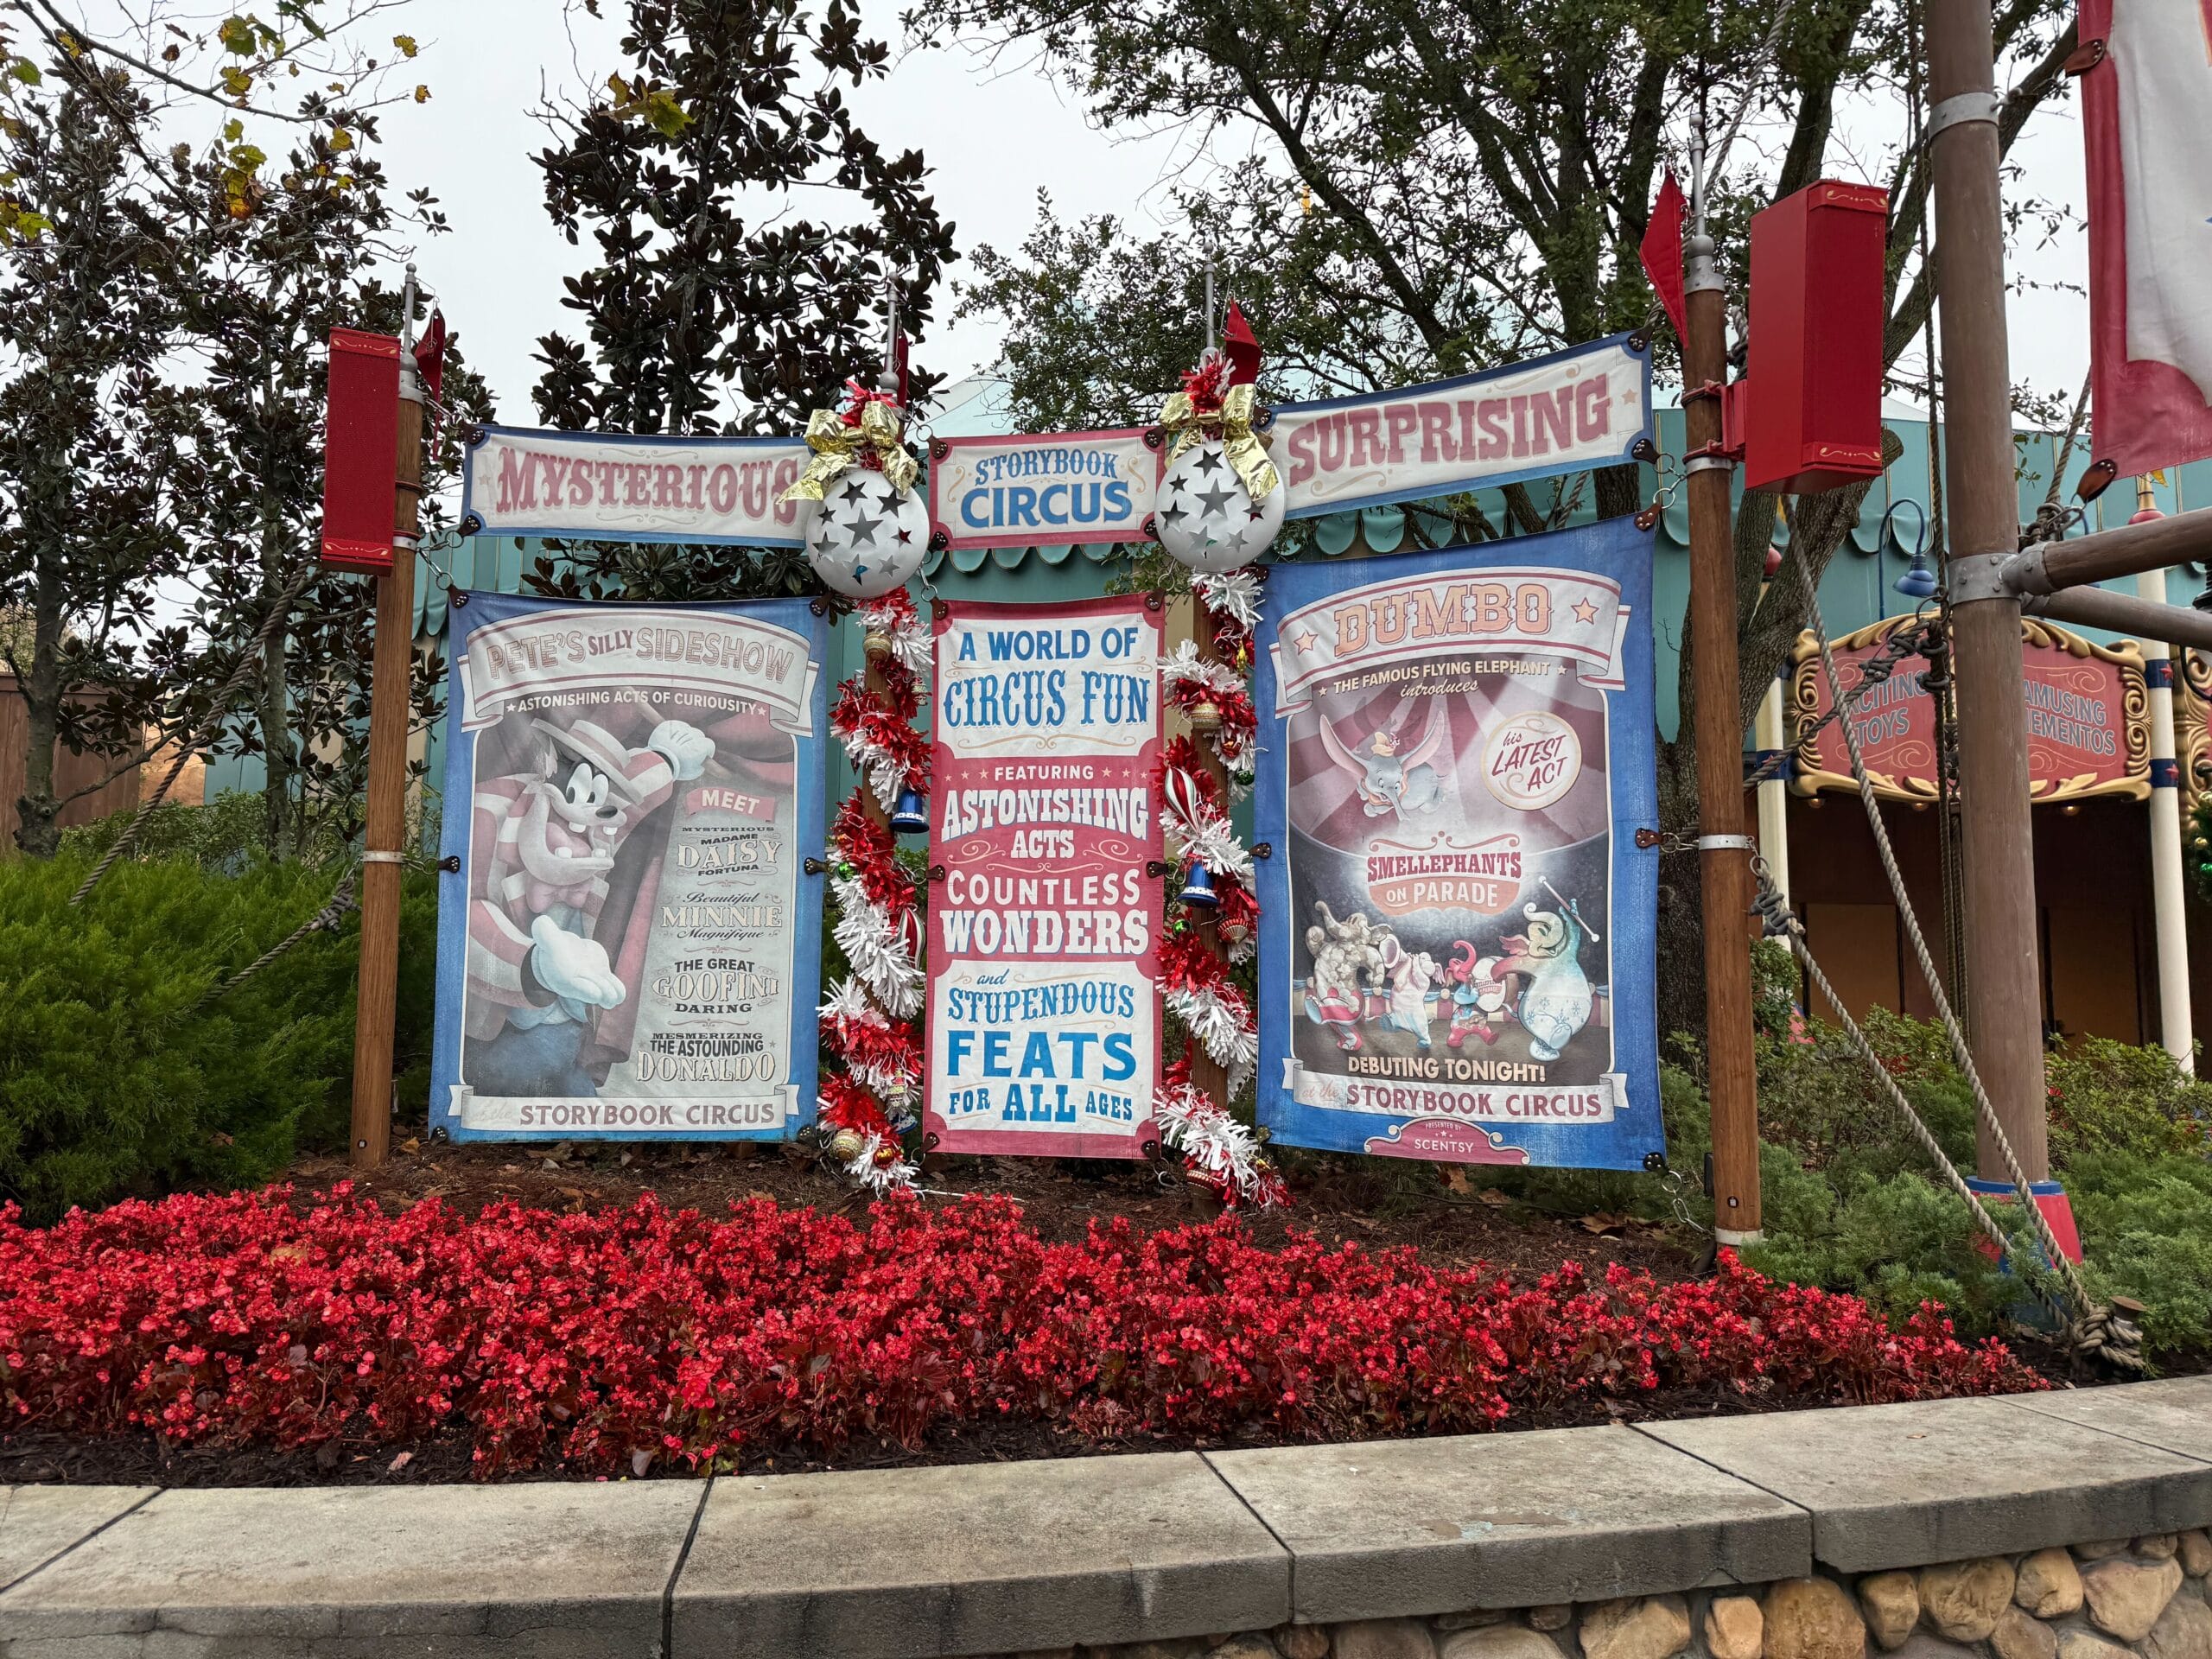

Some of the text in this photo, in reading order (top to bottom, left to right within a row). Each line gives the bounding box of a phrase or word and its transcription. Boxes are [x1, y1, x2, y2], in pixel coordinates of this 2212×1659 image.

[1287, 372, 1613, 488] SURPRISING
[975, 448, 1119, 486] STORYBOOK
[496, 447, 798, 526] MYSTERIOUS
[960, 480, 1133, 529] CIRCUS
[1334, 583, 1554, 658] DUMBO
[486, 626, 795, 683] PETE'S SILLY SIDESHOW
[958, 626, 1139, 661] A WORLD OF
[1333, 660, 1550, 694] THE FAMOUS FLYING ELEPHANT
[1400, 680, 1479, 698] introduces
[518, 690, 757, 715] ASTONISHING ACTS OF CURIOUSITY
[944, 669, 1150, 728] CIRCUS FUN
[1503, 731, 1523, 747] his
[1854, 707, 1910, 748] TOYS
[2024, 708, 2116, 756] EMENTOS
[1491, 734, 1567, 776] LATEST
[995, 765, 1094, 782] FEATURING
[1528, 756, 1568, 791] ACT
[702, 789, 760, 815] MEET
[941, 787, 1149, 842] ASTONISHING
[701, 833, 759, 845] MADAME
[1010, 830, 1075, 859] ACTS
[677, 840, 782, 869] DAISY
[1367, 852, 1522, 883] SMELLEPHANTS
[698, 865, 760, 876] FORTUNA
[683, 892, 760, 905] Beautiful
[947, 868, 1141, 906] COUNTLESS
[1385, 881, 1497, 907] ON PARADE
[660, 906, 782, 928] MINNIE
[939, 909, 1149, 955] WONDERS
[677, 928, 765, 941] Magnifique
[675, 958, 755, 972] THE GREAT
[976, 969, 1009, 985] and
[652, 971, 779, 1001] GOOFINI
[675, 1003, 753, 1014] DARING
[948, 981, 1135, 1024] STUPENDOUS
[650, 1039, 764, 1057] THE ASTOUNDING
[947, 1030, 1136, 1081] FEATS
[636, 1050, 776, 1082] DONALDO
[1348, 1056, 1547, 1083] DEBUTING TONIGHT!
[949, 1083, 1132, 1122] FOR ALL AGES
[1319, 1081, 1339, 1099] the
[1347, 1084, 1494, 1116] STORYBOOK
[1505, 1094, 1602, 1116] CIRCUS
[520, 1104, 673, 1126] STORYBOOK
[686, 1103, 775, 1126] CIRCUS
[1425, 1122, 1453, 1130] PRESENTED
[1414, 1139, 1474, 1153] SCENTSY
